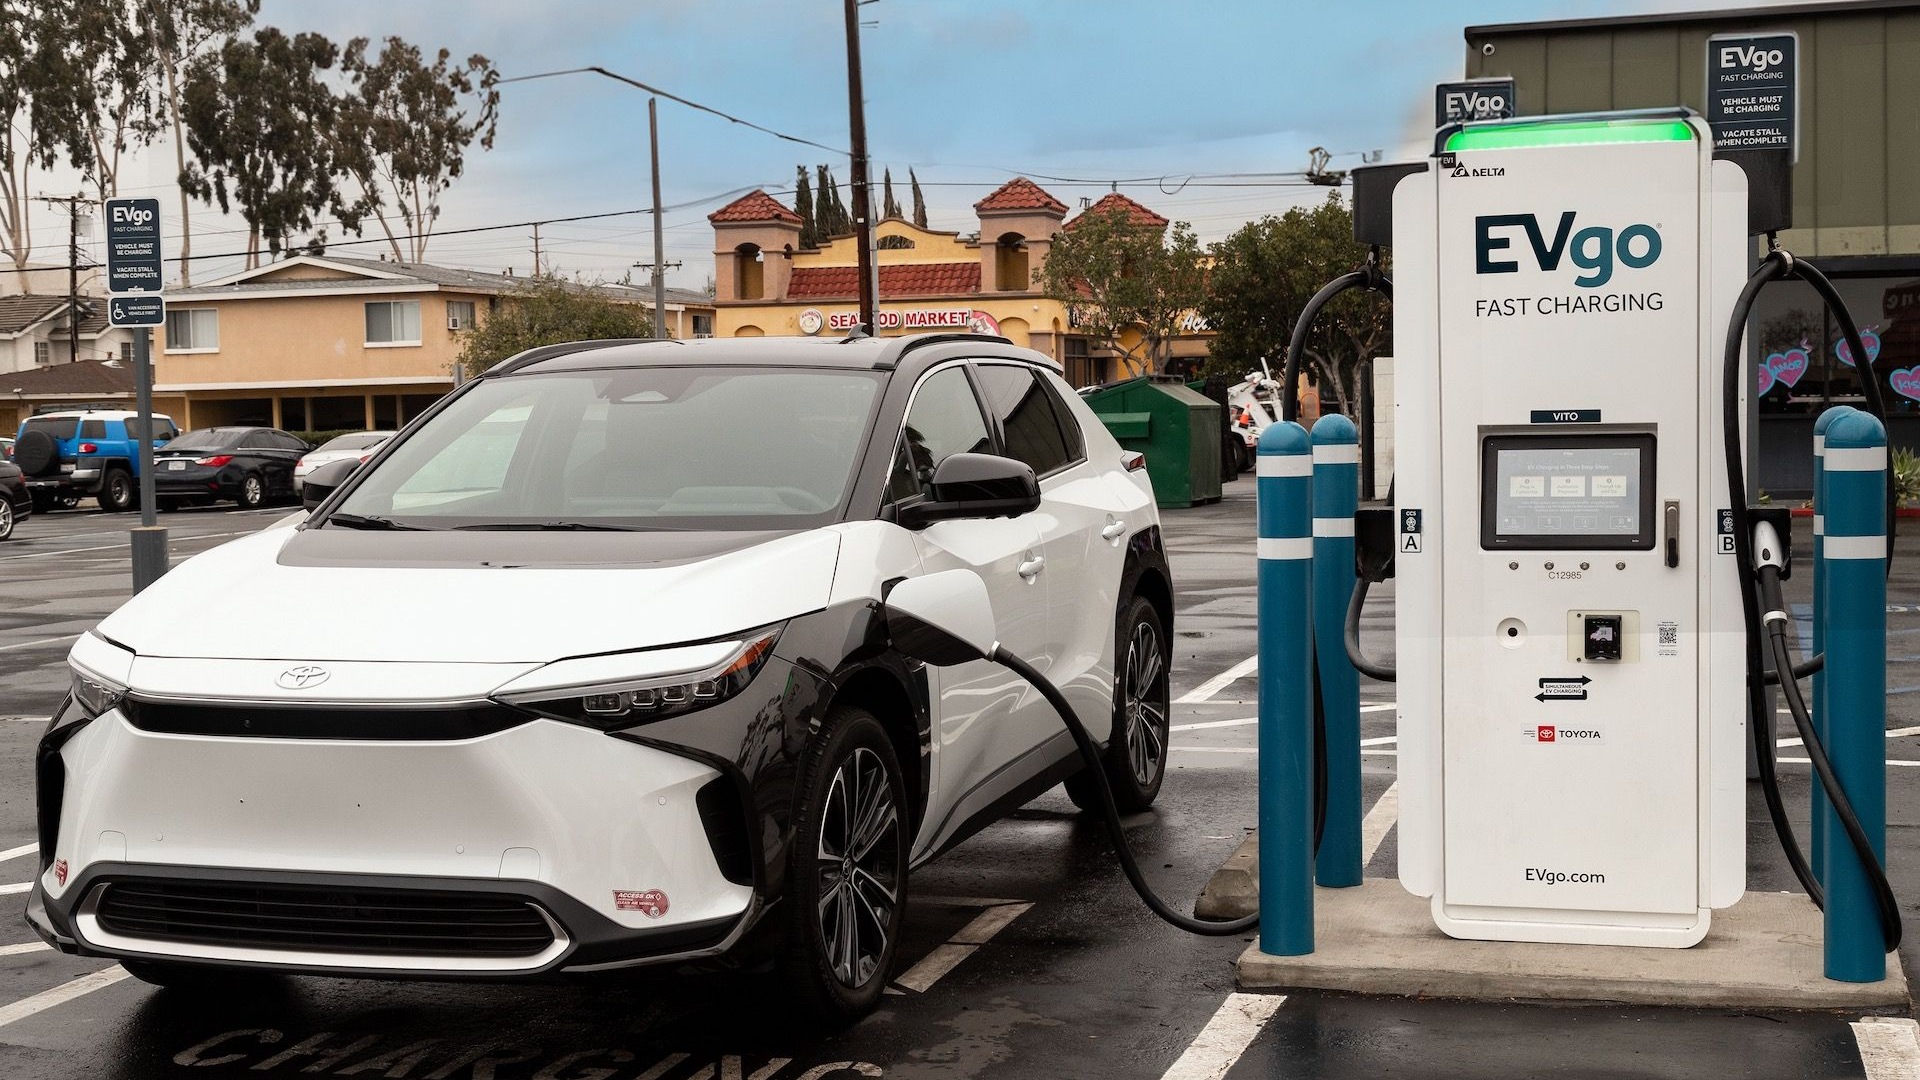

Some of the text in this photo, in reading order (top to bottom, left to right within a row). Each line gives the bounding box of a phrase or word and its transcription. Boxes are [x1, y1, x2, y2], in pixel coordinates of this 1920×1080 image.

[1721, 46, 1783, 71] EVgo
[1721, 71, 1783, 82] FAST CHARGING
[1445, 92, 1505, 116] EVgo
[1721, 95, 1783, 105] VEHICLE MUST
[1724, 104, 1780, 114] BE CHARGING
[1722, 128, 1781, 138] VACATE STALL
[1716, 136, 1787, 146] WHEN COMPLETE
[1472, 167, 1505, 177] DELTA
[113, 206, 153, 226] EVgo
[1475, 211, 1662, 288] EVgo
[1476, 292, 1664, 317] FAST CHARGING
[830, 311, 968, 328] SEAOD MARKET
[1553, 412, 1578, 421] VITO
[1405, 535, 1418, 550] A
[1723, 536, 1735, 551] B
[1548, 571, 1582, 580] C12985
[1558, 730, 1601, 739] TOYOTA
[1525, 868, 1605, 886] EVgo.com
